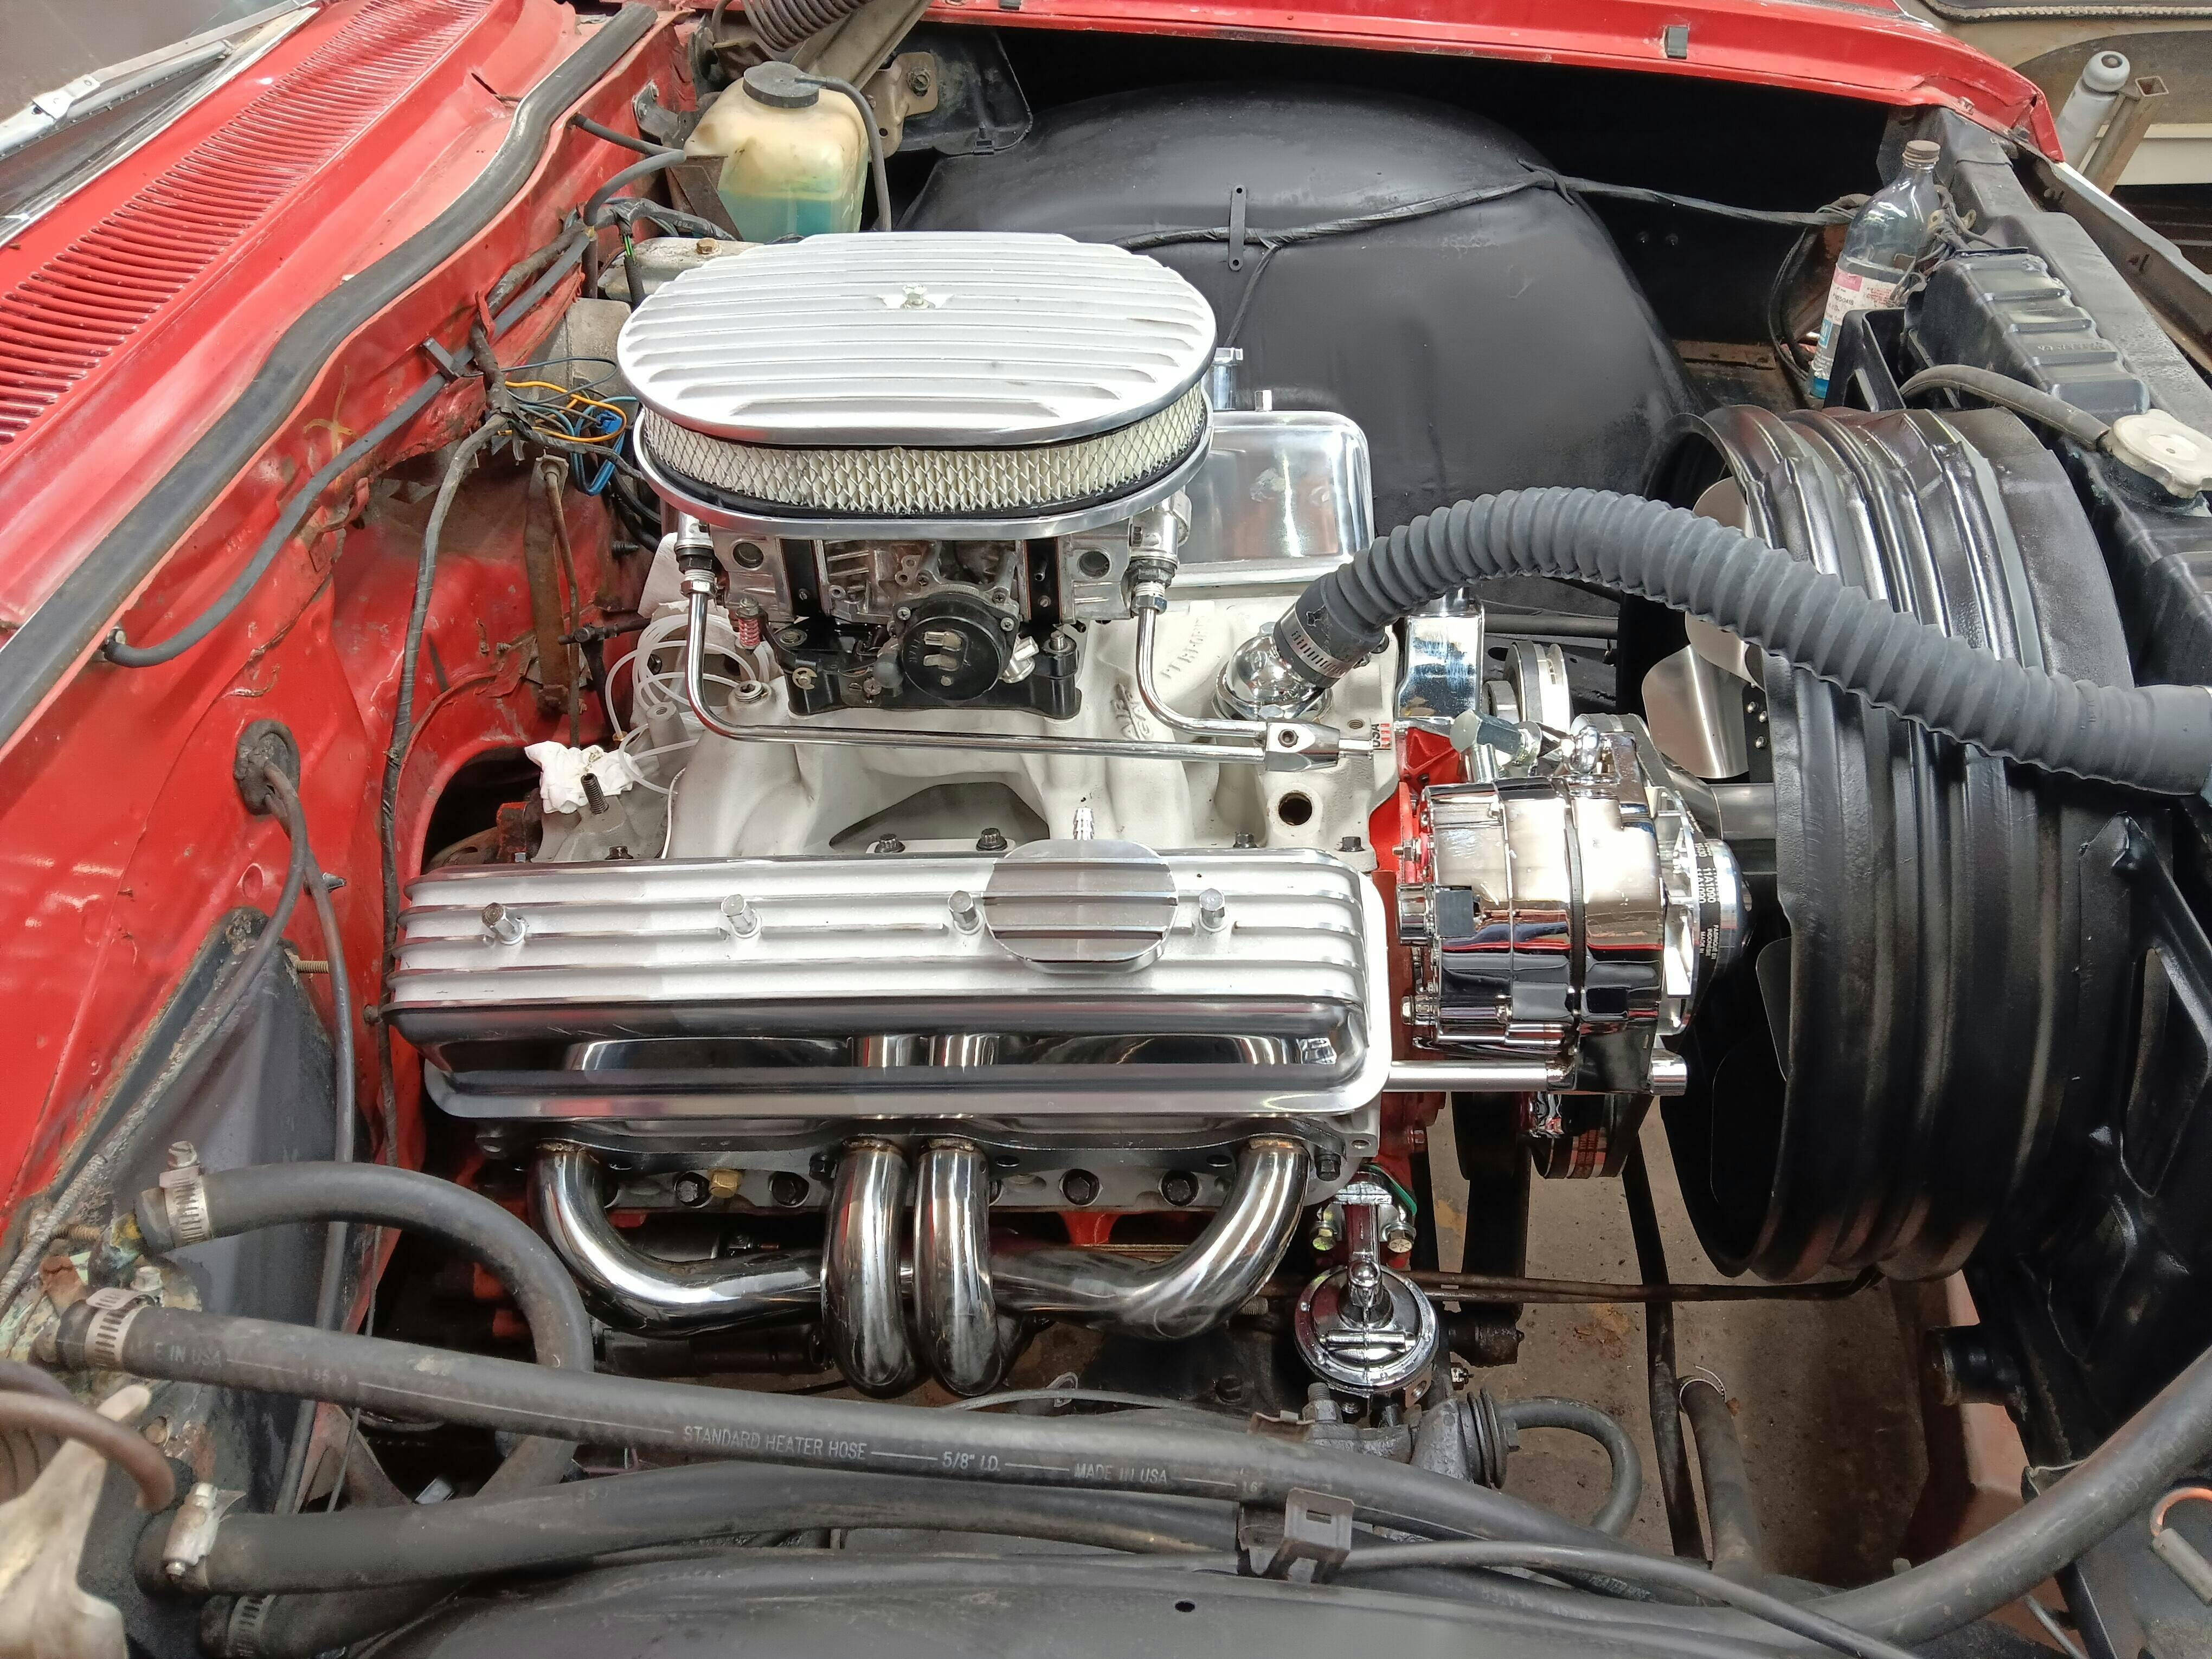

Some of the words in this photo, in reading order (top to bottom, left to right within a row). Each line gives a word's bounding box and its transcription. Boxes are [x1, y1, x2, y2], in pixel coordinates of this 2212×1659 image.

[1371, 724, 1380, 747] USA
[1702, 868, 1716, 903] 11A1090
[683, 1426, 760, 1449] STANDARD
[765, 1434, 823, 1456] HEATER
[828, 1440, 867, 1460] HOSE
[942, 1451, 975, 1470] 5/8"
[1074, 1463, 1112, 1481] MADE
[1119, 1467, 1134, 1483] IN
[1140, 1467, 1167, 1484] USA
